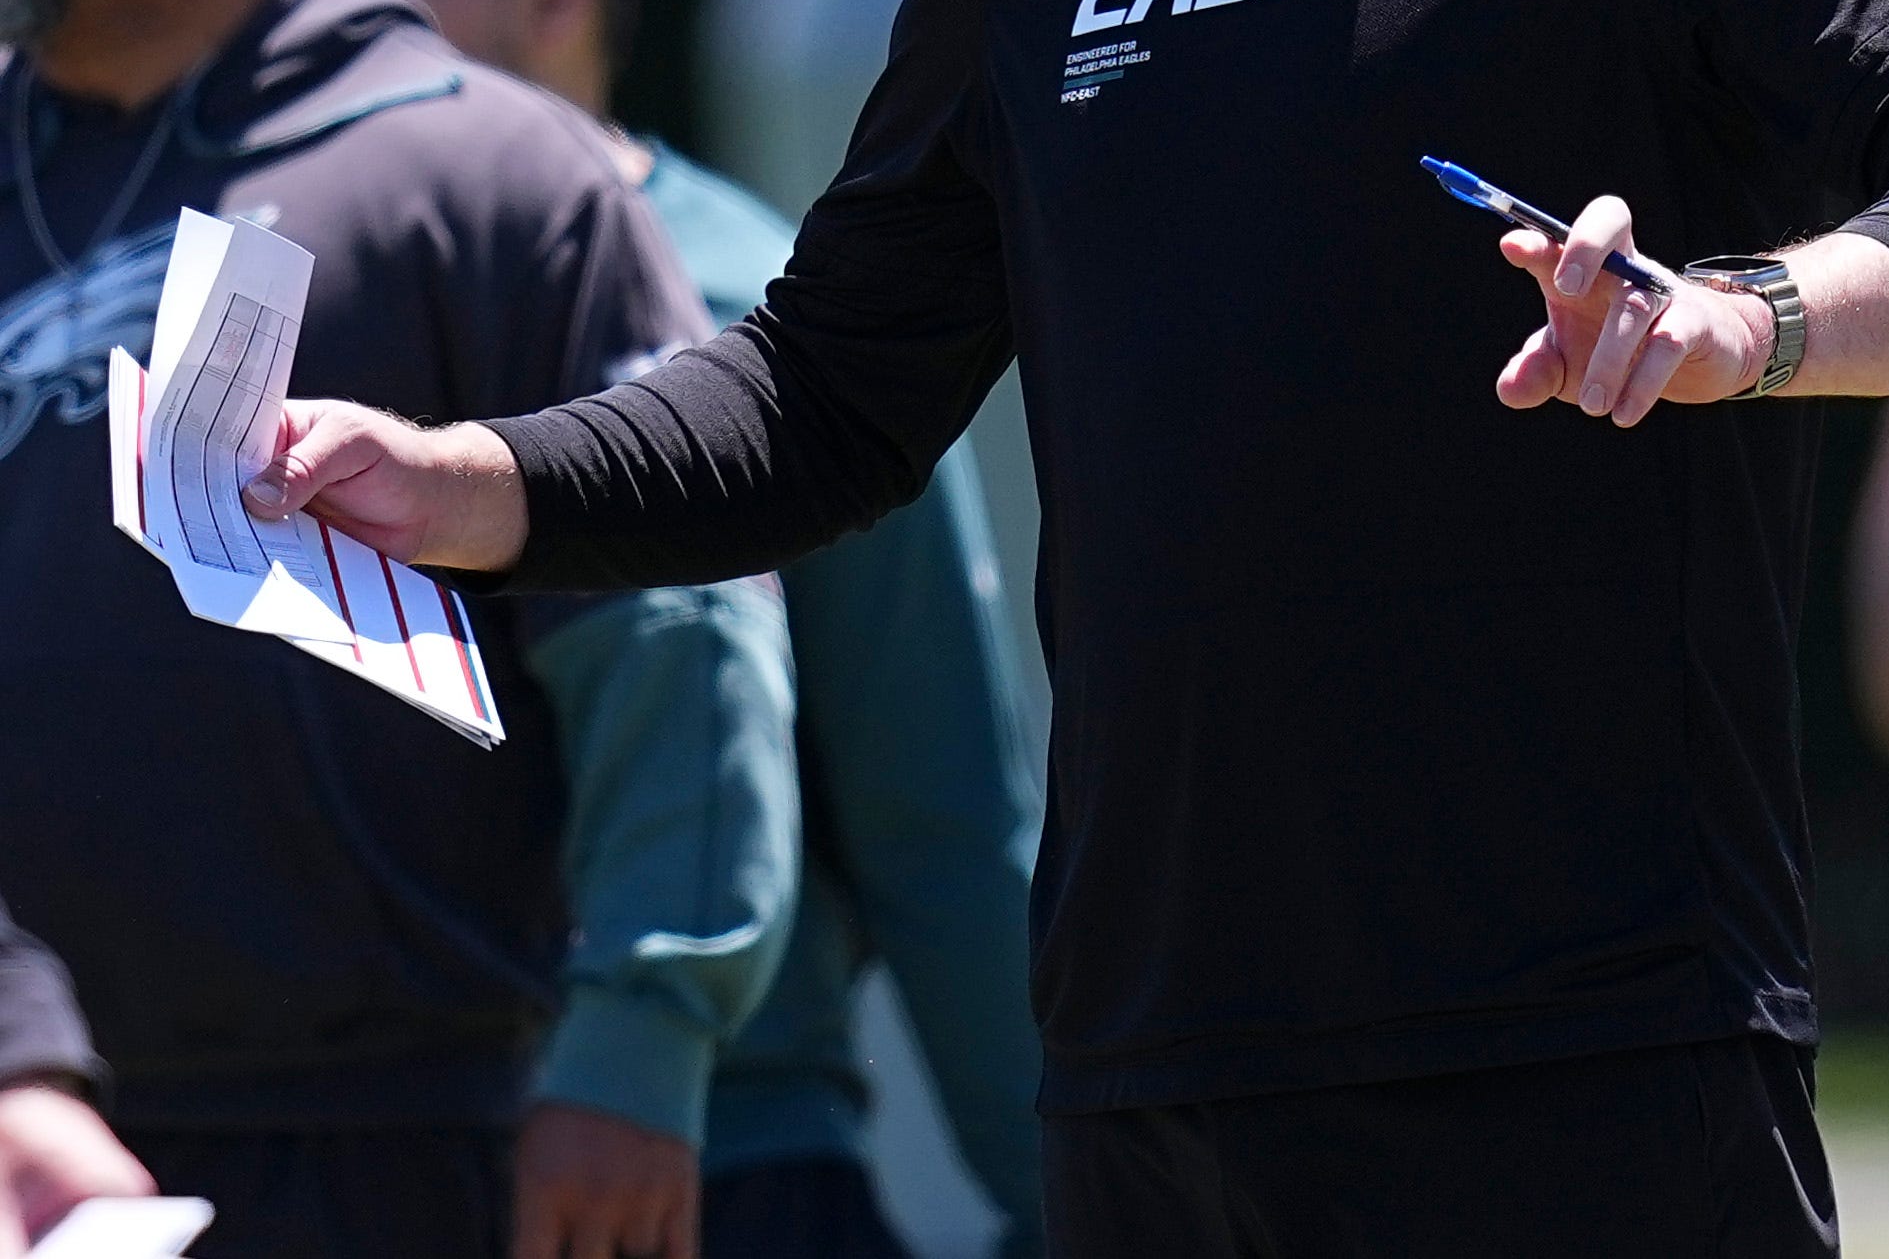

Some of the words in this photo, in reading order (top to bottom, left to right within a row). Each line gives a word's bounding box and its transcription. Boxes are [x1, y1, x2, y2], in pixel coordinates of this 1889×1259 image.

[1064, 57, 1117, 77] PHILADELPHIA
[1118, 51, 1151, 66] EAGLES
[1066, 44, 1118, 65] ENGINEERED
[1119, 40, 1137, 53] FOR
